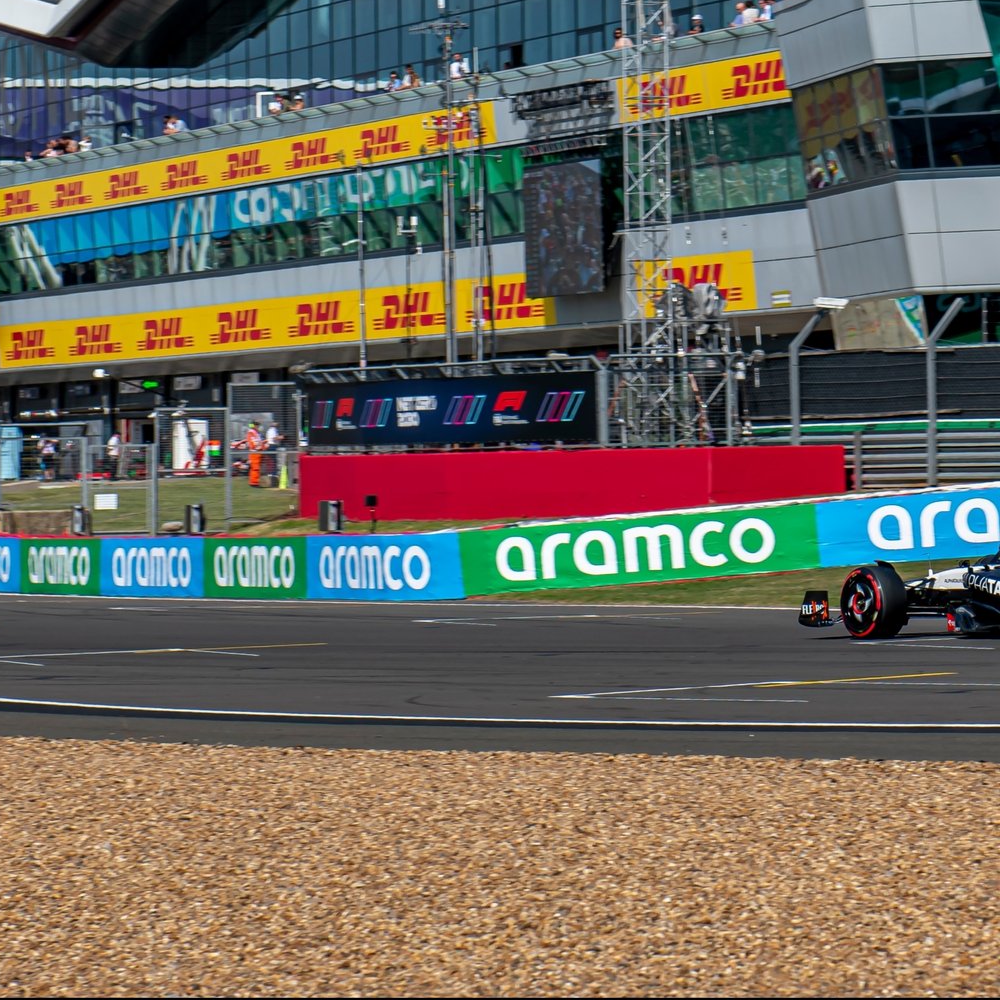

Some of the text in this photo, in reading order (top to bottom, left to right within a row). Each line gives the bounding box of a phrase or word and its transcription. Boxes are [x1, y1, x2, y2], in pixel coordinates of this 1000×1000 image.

[732, 59, 786, 99] DHL
[291, 137, 330, 169] DHL
[360, 125, 400, 158] DHL
[167, 160, 200, 191] DHL
[227, 149, 262, 179] DHL
[55, 181, 84, 208] DHL
[109, 171, 140, 199] DHL
[296, 301, 345, 337] DHL
[382, 291, 436, 329] DHL
[475, 282, 533, 322] DHL
[76, 324, 116, 355] DHL
[143, 317, 185, 350] DHL
[217, 309, 262, 344] DHL
[12, 330, 48, 360] DHL
[28, 546, 90, 586] aramco
[213, 545, 295, 589] aramco
[495, 518, 776, 581] aramco
[112, 547, 192, 588] aramco
[318, 545, 431, 590] aramco
